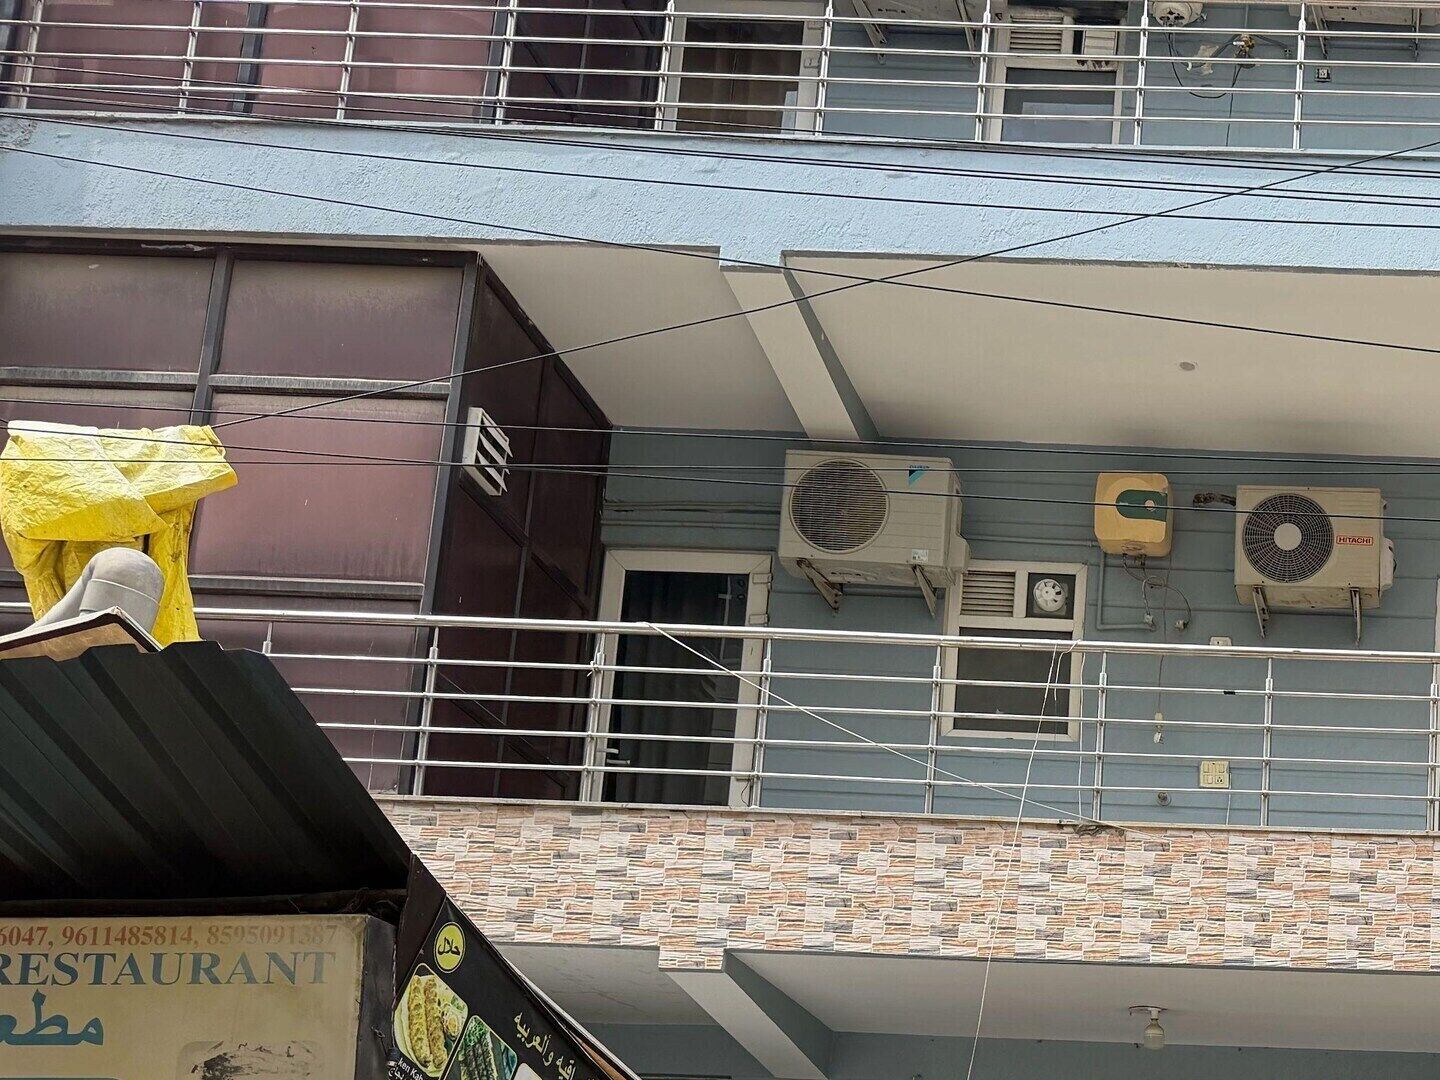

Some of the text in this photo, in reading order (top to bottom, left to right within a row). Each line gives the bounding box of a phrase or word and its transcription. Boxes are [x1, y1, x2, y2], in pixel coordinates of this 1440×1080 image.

[1338, 536, 1371, 545] HITACHI
[62, 926, 199, 950] 9611485814,
[438, 937, 460, 955] حلال
